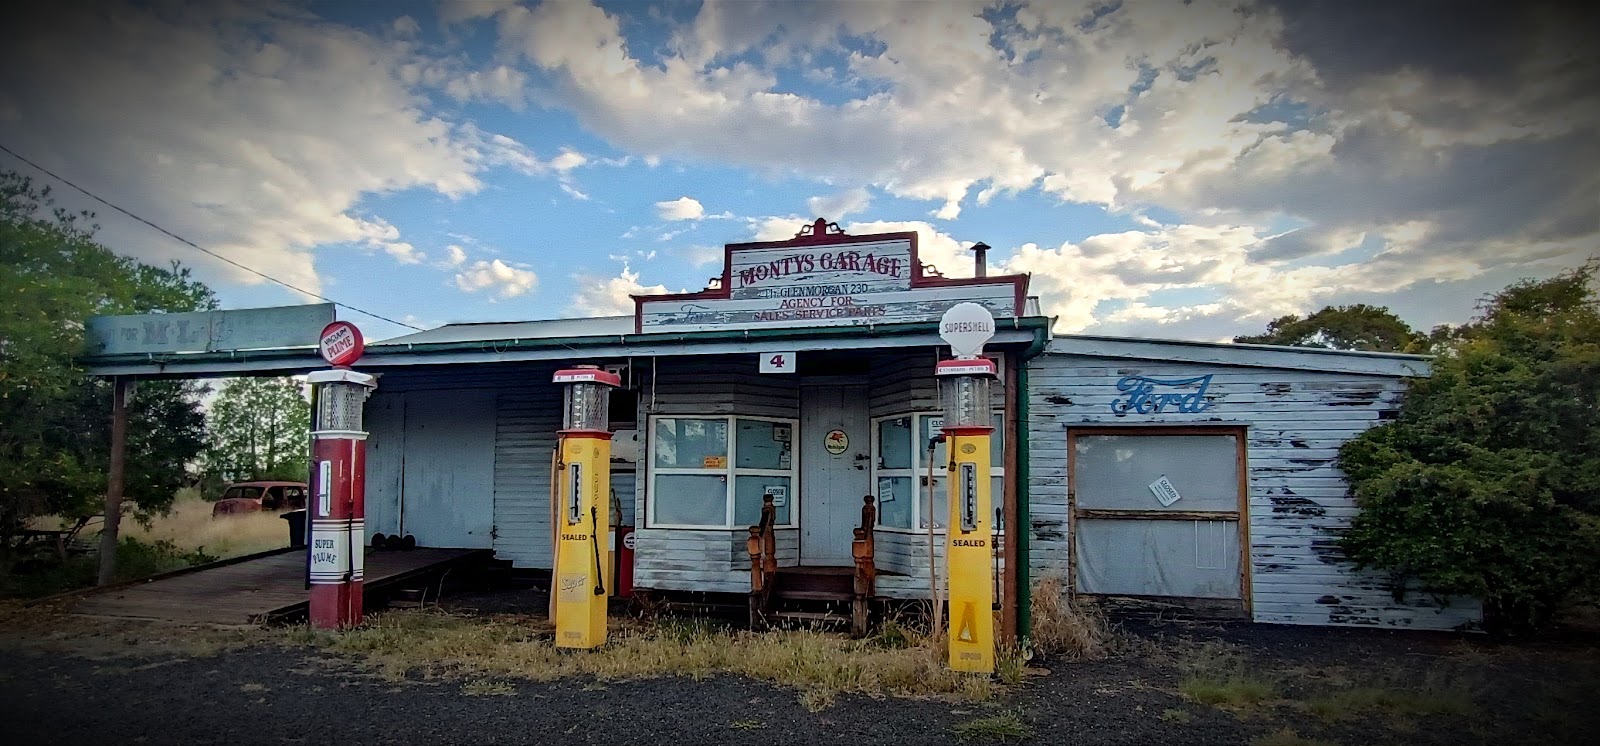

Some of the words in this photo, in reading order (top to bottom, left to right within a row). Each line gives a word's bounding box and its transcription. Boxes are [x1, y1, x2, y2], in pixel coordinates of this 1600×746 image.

[739, 252, 815, 288] MONTYS
[820, 251, 902, 279] GARAGE
[850, 283, 868, 293] 23D
[780, 297, 826, 309] AGENCY
[831, 296, 853, 306] FOR
[754, 310, 789, 321] SALES
[795, 308, 841, 319] SERVICE
[945, 321, 989, 333] SUPERSHELL
[324, 328, 347, 346] VACUUM
[327, 336, 353, 358] PLUME
[769, 354, 785, 368] 4
[1110, 374, 1214, 414] Ford
[1160, 479, 1177, 499] CLOSED
[314, 539, 334, 549] SUPER
[952, 539, 986, 547] SEALED
[313, 552, 337, 565] PLUME
